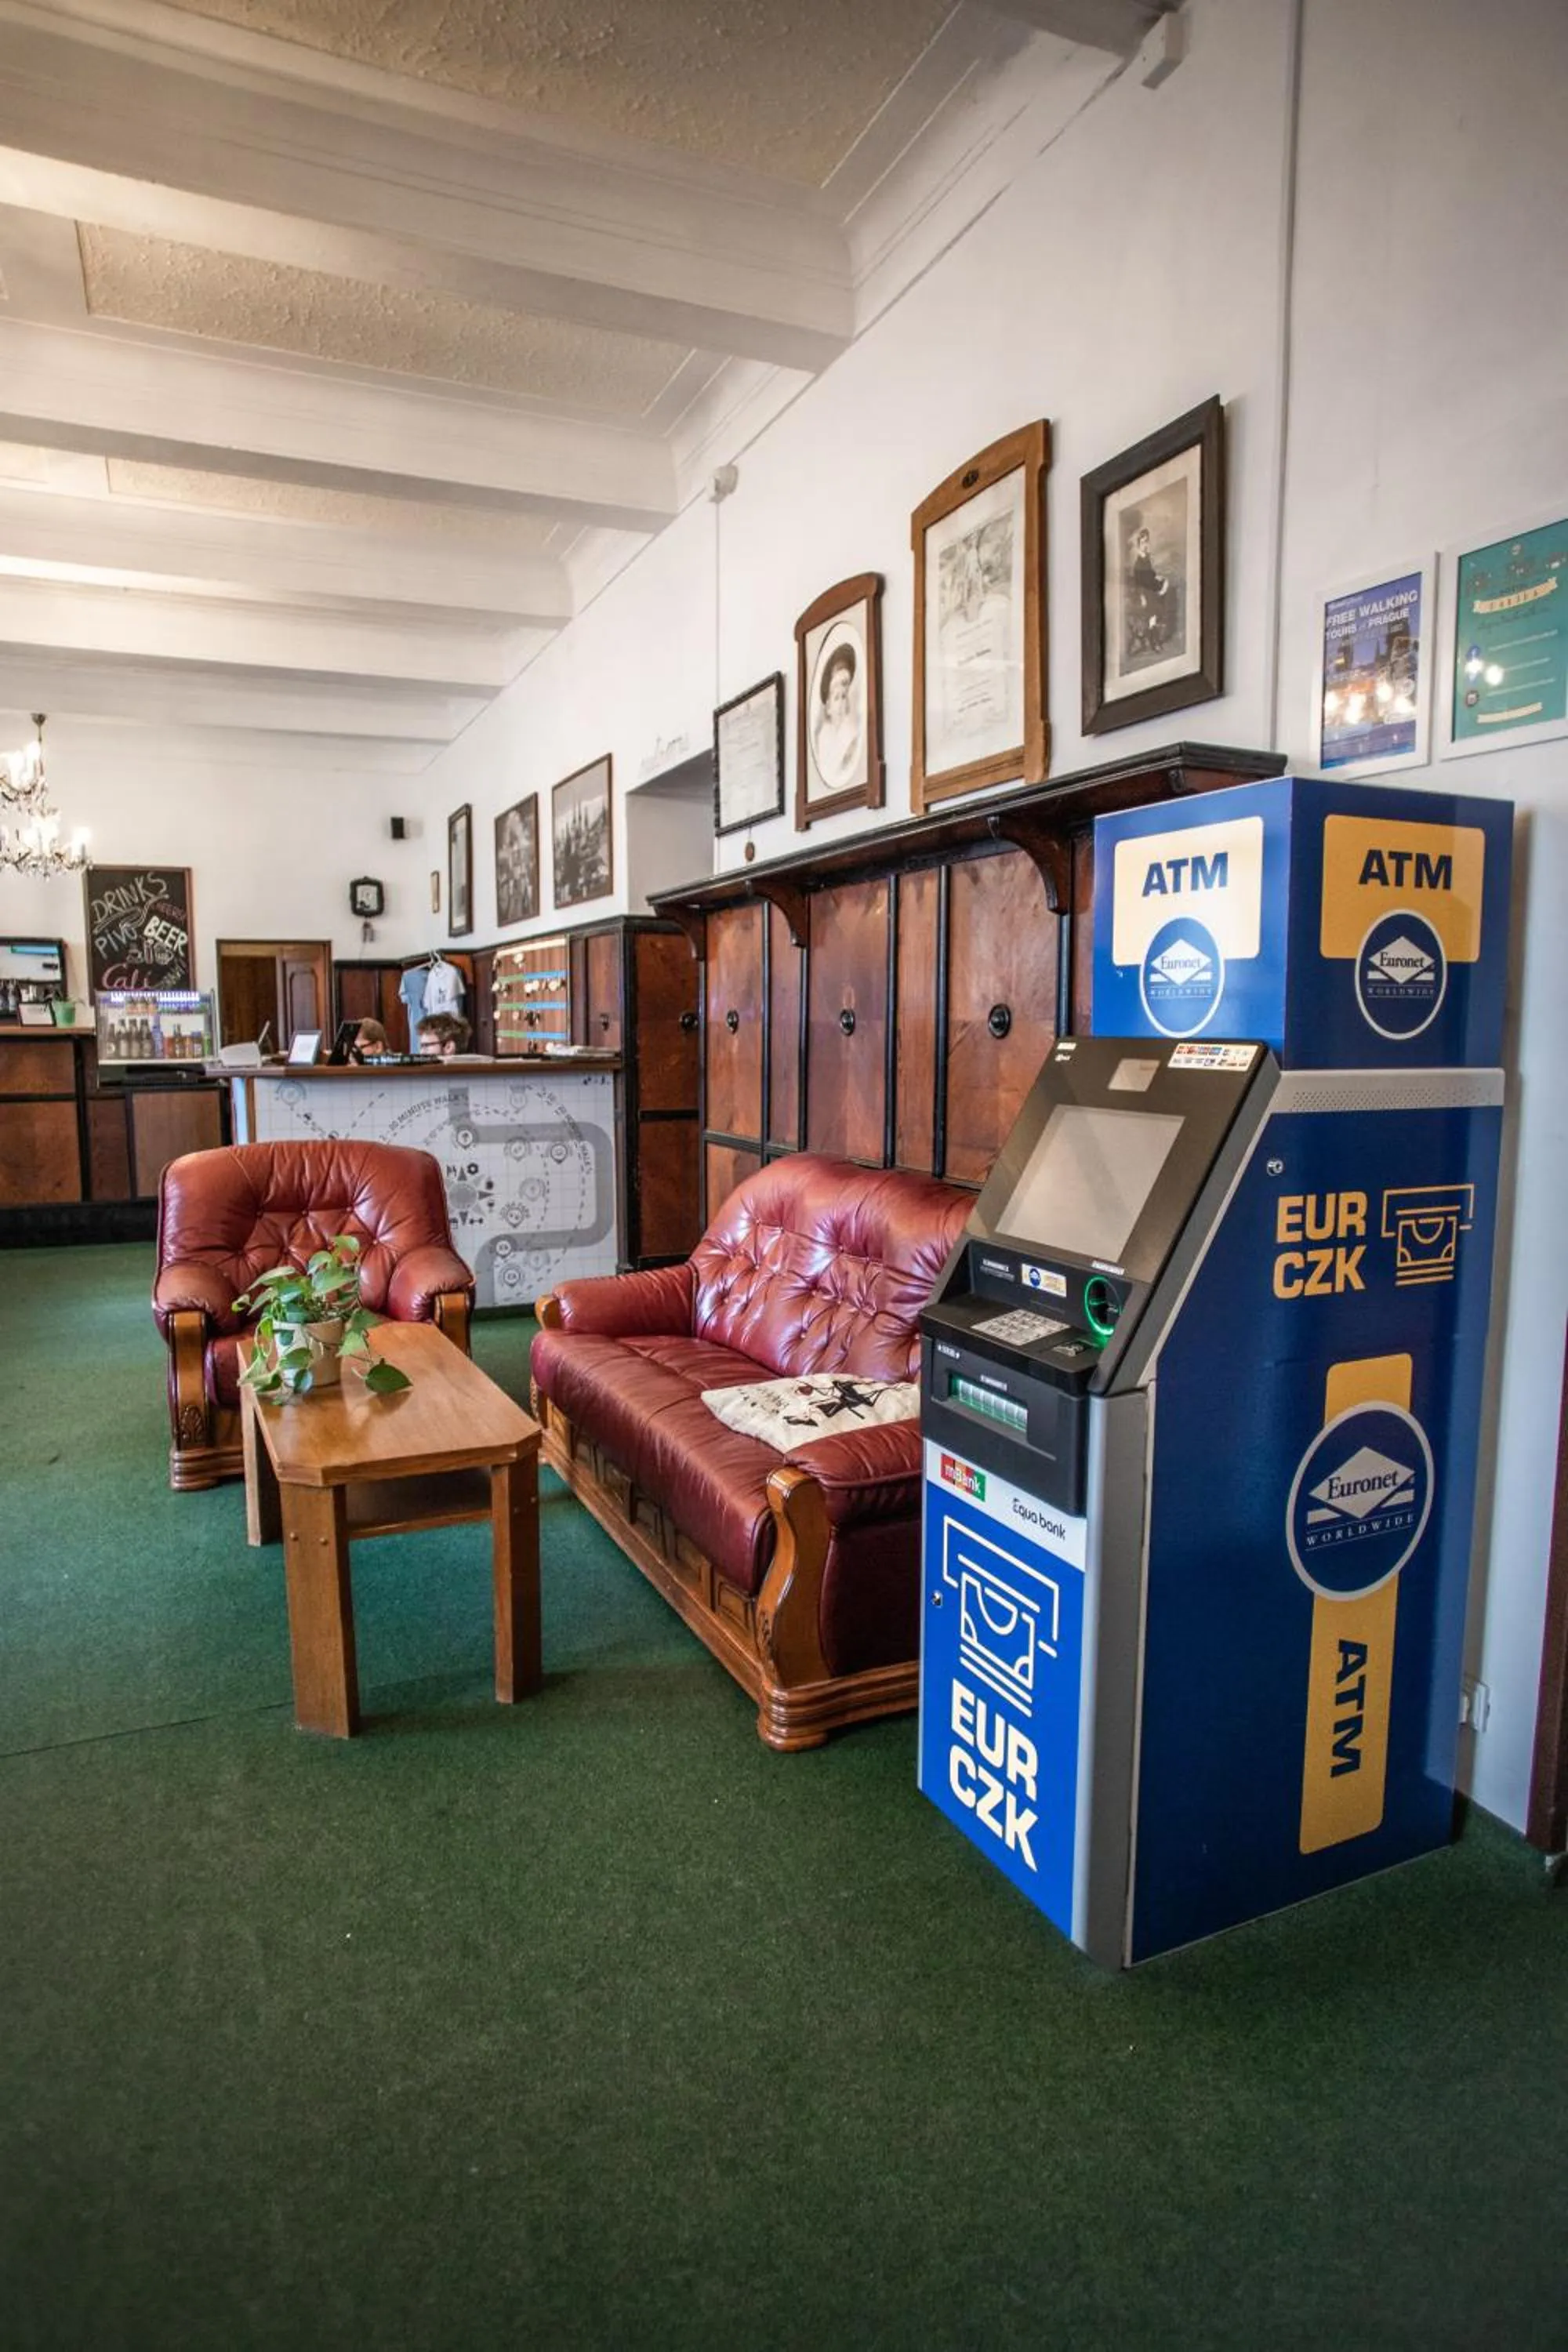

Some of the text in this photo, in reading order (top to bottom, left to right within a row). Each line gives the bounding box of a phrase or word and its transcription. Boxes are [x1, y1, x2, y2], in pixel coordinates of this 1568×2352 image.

[1325, 623, 1357, 641] TOURS
[1367, 608, 1410, 628] PRAGUE
[1327, 608, 1356, 627] FREE
[1359, 589, 1418, 617] WALKING
[1142, 851, 1229, 897] ATM
[1358, 848, 1454, 891] ATM
[90, 871, 168, 924] DRINKS
[93, 922, 138, 961] PIVO
[143, 915, 188, 957] BEER
[1161, 956, 1201, 970] Euronet
[1380, 952, 1425, 968] Euronet
[1367, 987, 1435, 996] WORLDWIDE
[1276, 1190, 1369, 1243] EUR
[1272, 1244, 1367, 1300] CZK
[945, 1464, 982, 1494] mBank
[1326, 1468, 1400, 1501] Euronet
[1012, 1497, 1066, 1541] Equa bank
[1305, 1512, 1415, 1547] WORLDWIDE
[1330, 1638, 1368, 1779] ATM
[951, 1678, 1038, 1802] EUR
[949, 1744, 1038, 1874] CZK
